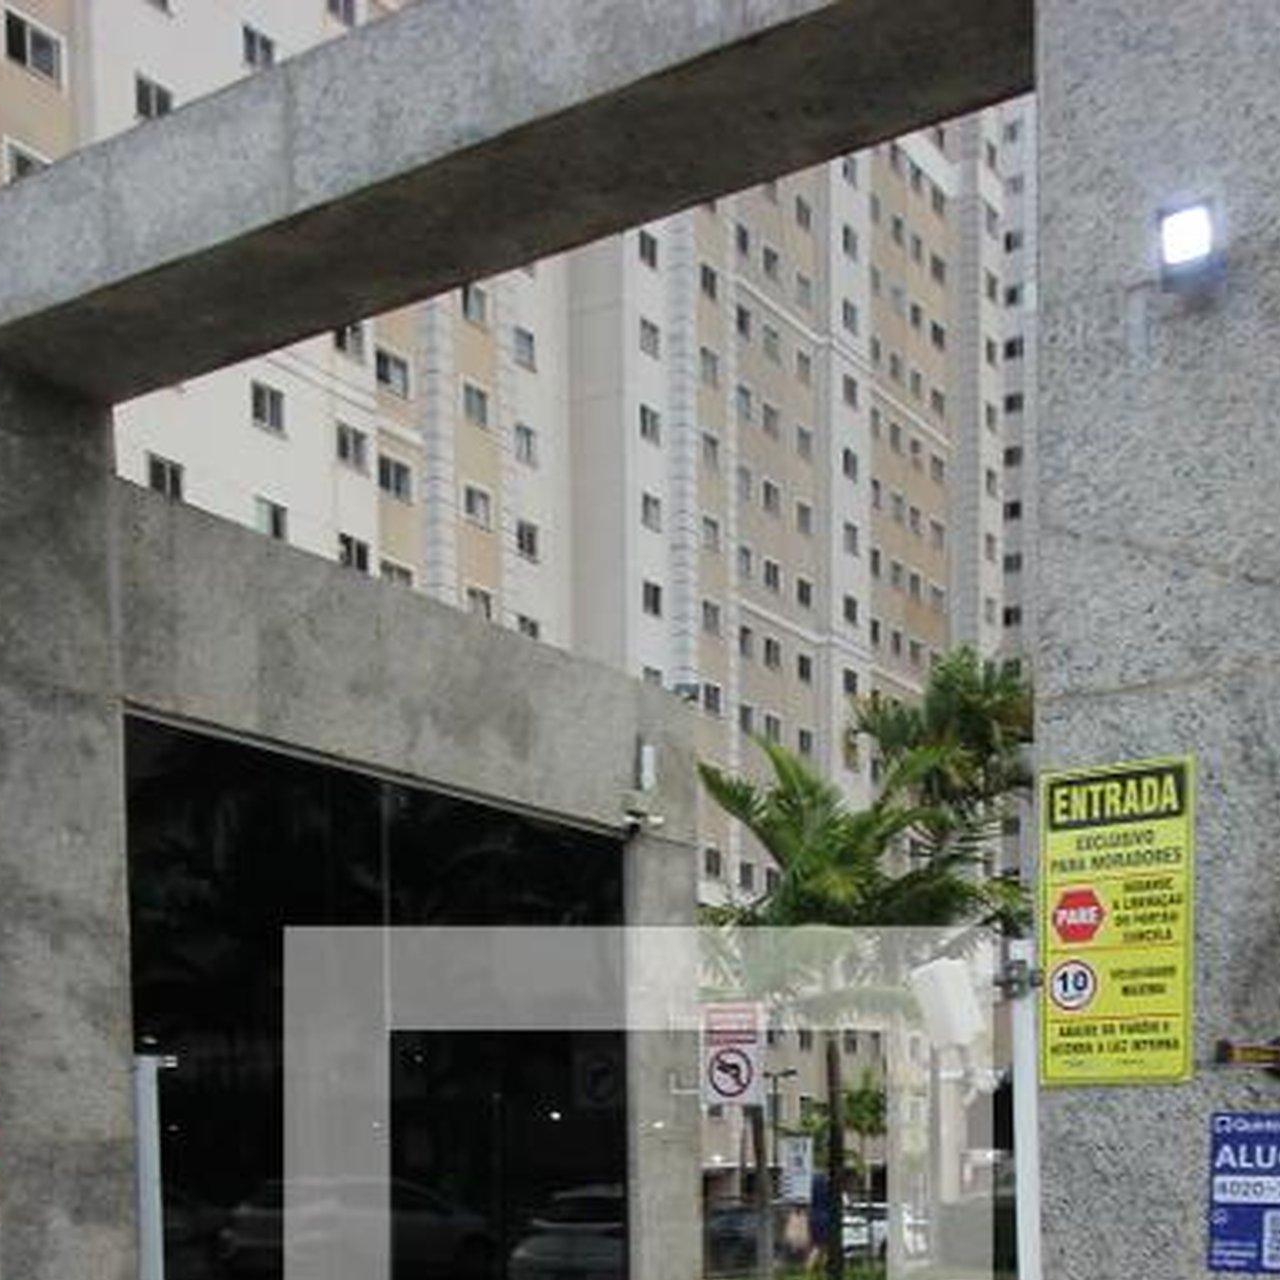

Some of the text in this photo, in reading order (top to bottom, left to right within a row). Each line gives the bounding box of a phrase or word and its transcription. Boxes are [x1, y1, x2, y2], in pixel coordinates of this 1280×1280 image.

[1053, 774, 1179, 823] ENTRADA
[1076, 830, 1154, 851] EXCLUSIVO
[1050, 847, 1183, 874] PARA MORADORES
[1055, 906, 1101, 925] PARE
[1058, 970, 1088, 993] 10
